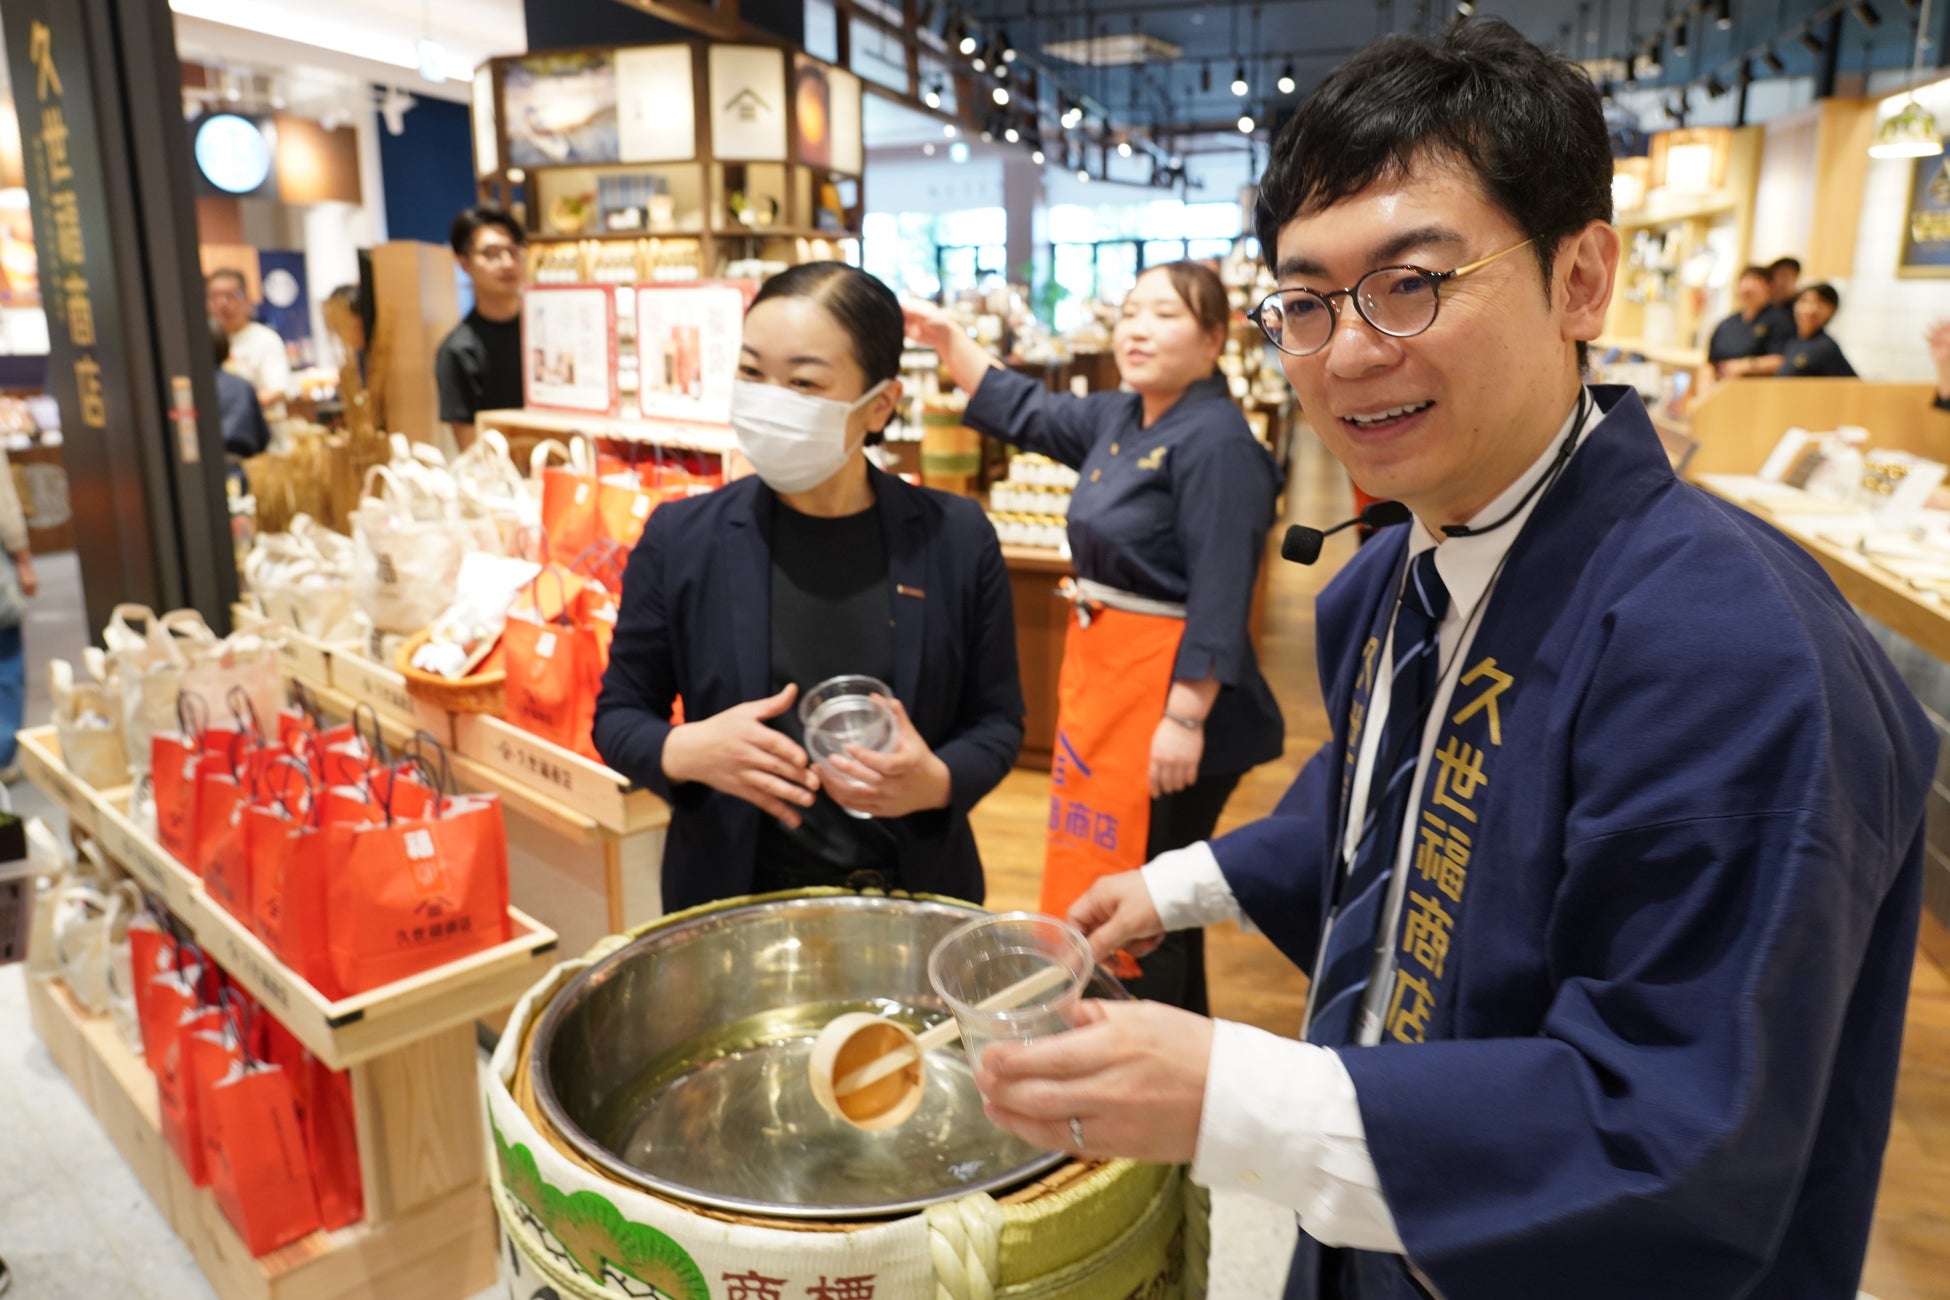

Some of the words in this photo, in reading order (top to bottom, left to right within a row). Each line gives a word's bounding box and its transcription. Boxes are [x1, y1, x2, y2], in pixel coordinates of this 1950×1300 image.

[30, 20, 106, 427] 久世福商店
[1386, 657, 1514, 1043] 久世福商店
